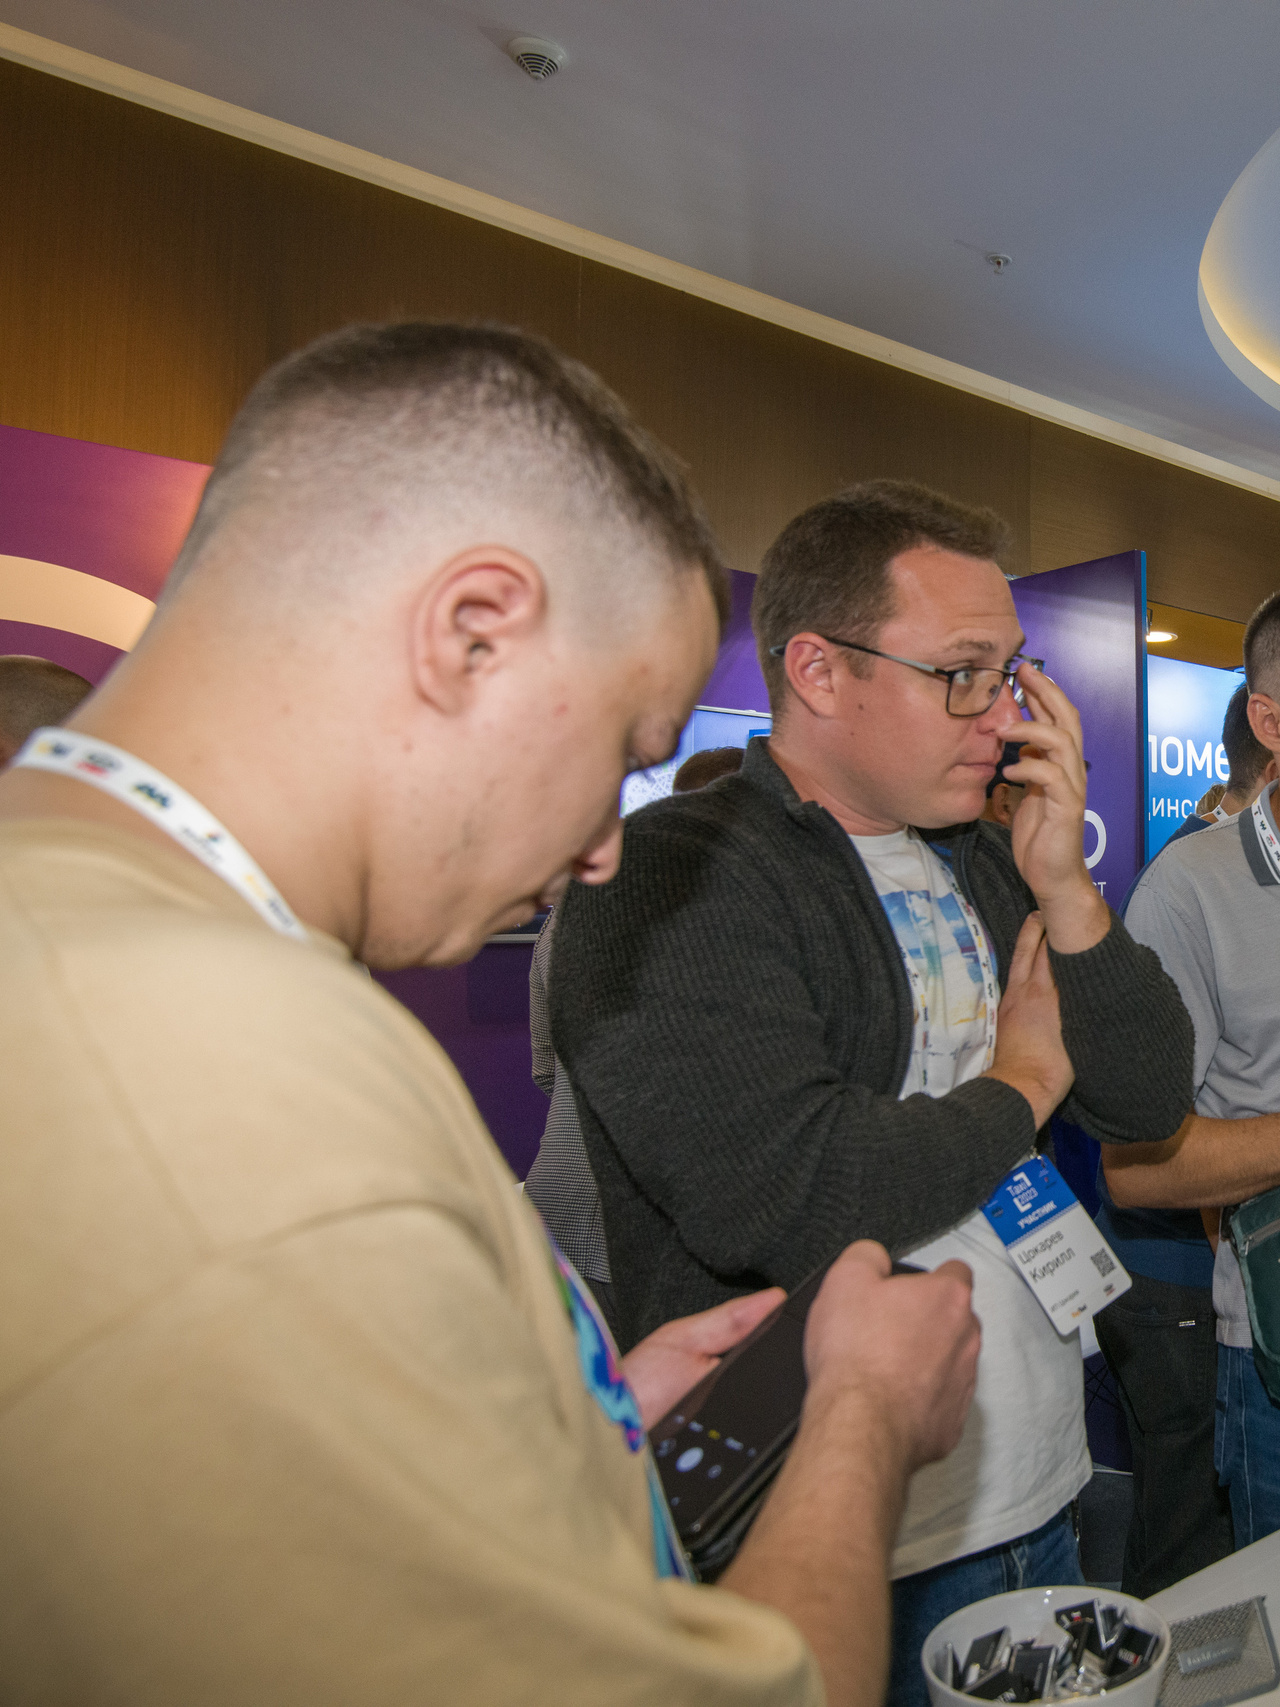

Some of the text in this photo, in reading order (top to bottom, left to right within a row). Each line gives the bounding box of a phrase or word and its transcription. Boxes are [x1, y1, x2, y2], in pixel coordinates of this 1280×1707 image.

[1018, 1187, 1039, 1206] 2023
[1016, 1200, 1058, 1230] УЧАСТНИК
[1028, 1247, 1076, 1283] Кирилл
